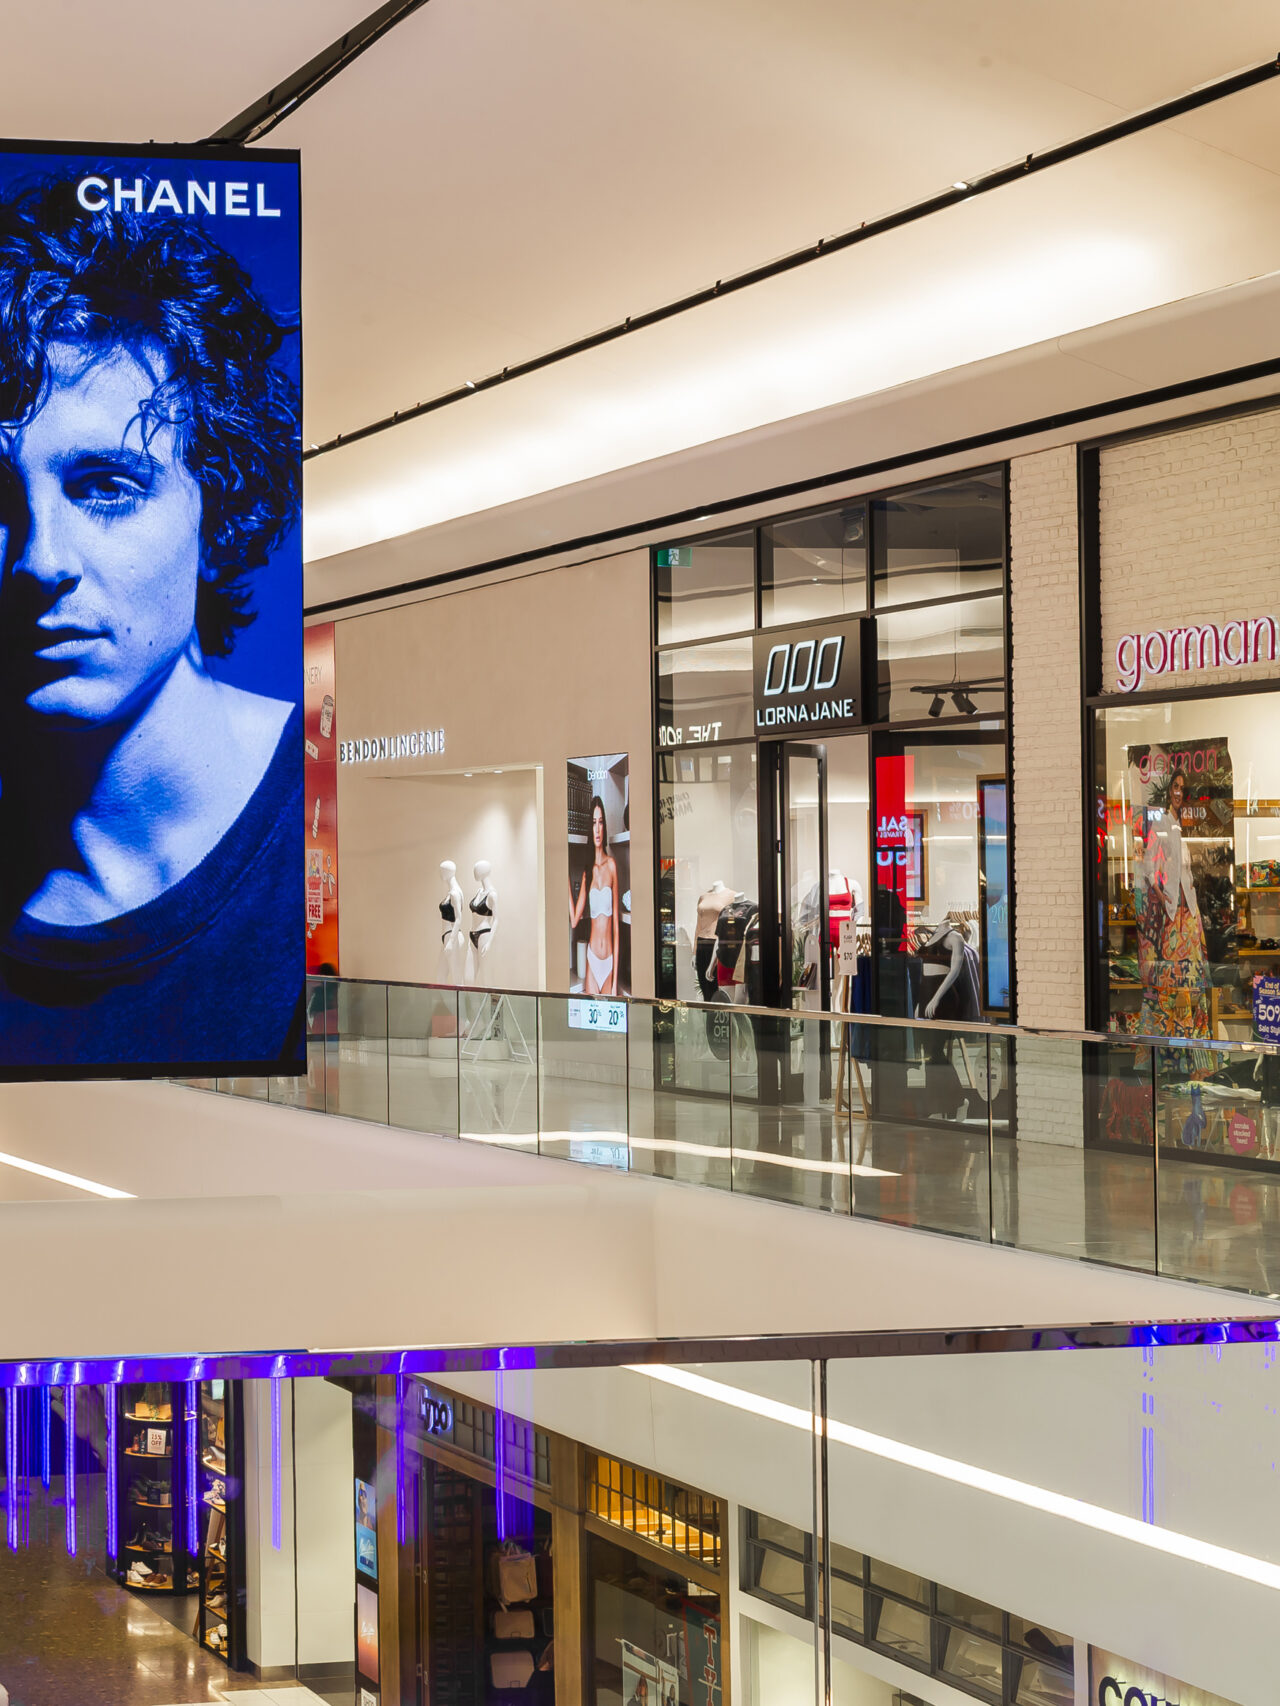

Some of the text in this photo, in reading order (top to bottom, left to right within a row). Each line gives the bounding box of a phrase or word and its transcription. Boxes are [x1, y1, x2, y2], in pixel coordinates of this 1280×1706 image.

[76, 176, 281, 217] CHANEL
[1116, 616, 1276, 693] gorman
[756, 698, 854, 727] LORNA JANE
[339, 729, 446, 764] BENDON LINGERIE
[1139, 749, 1218, 784] gorman
[308, 903, 321, 919] FREE
